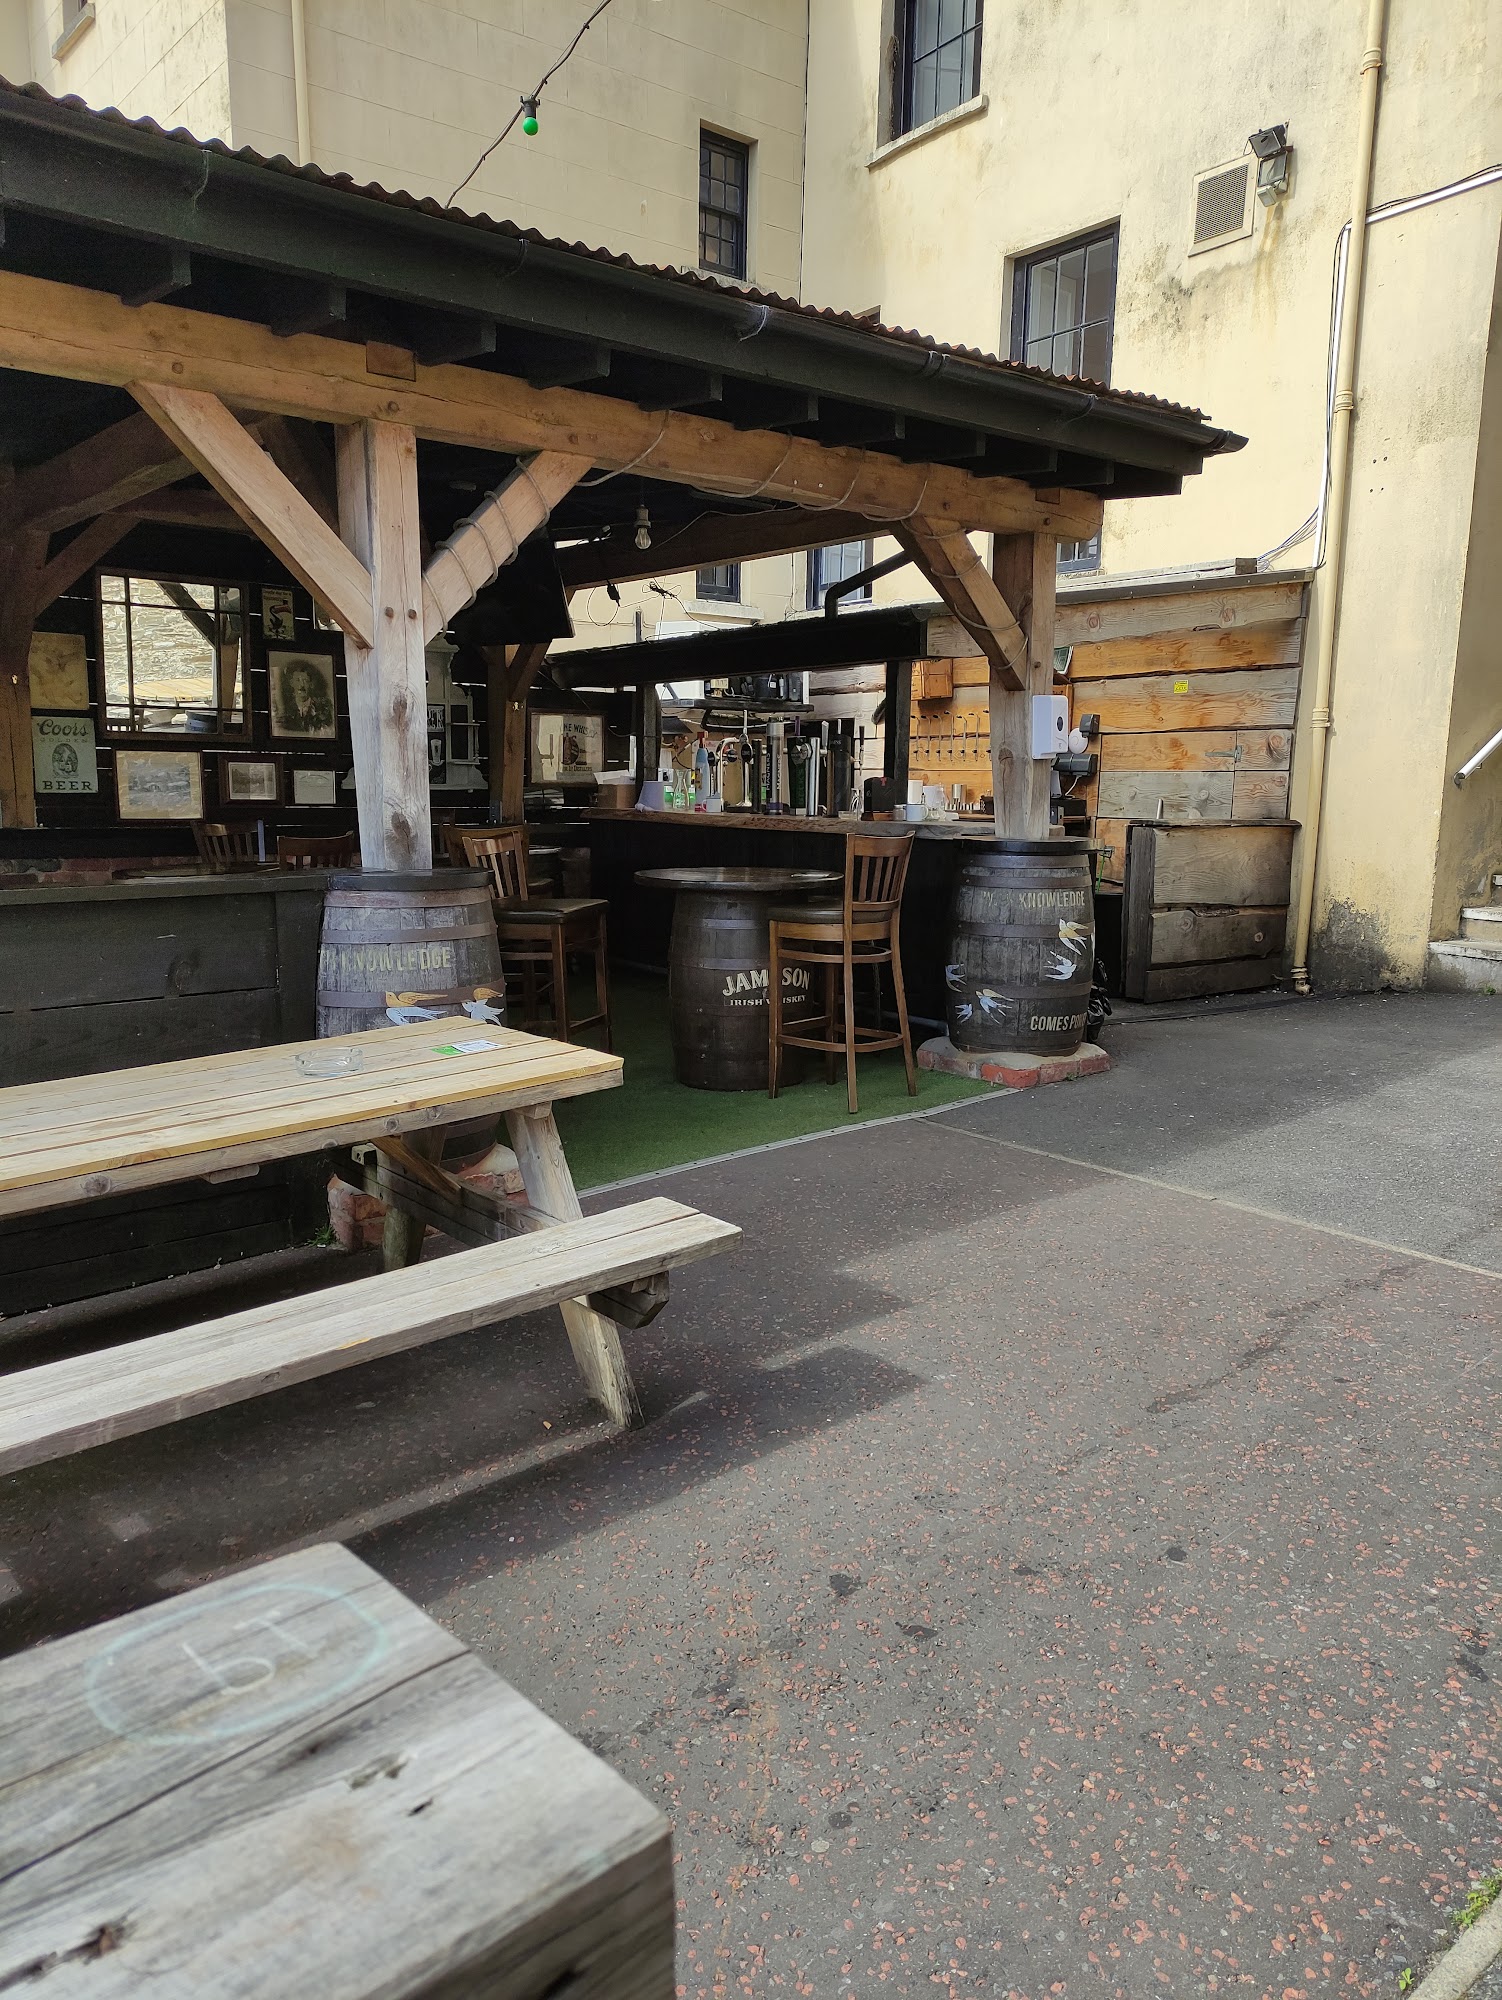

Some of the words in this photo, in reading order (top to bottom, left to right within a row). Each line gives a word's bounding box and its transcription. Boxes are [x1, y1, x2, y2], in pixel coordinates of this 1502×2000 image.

[37, 718, 89, 737] Coors
[42, 780, 93, 791] BEER
[1018, 890, 1086, 908] KNOWLEDGE
[340, 946, 452, 972] KNOWLEDGE
[722, 967, 811, 997] JAMSON
[730, 998, 763, 1006] IRISH
[765, 994, 806, 1006] WISKEY
[1030, 1015, 1070, 1031] COMES
